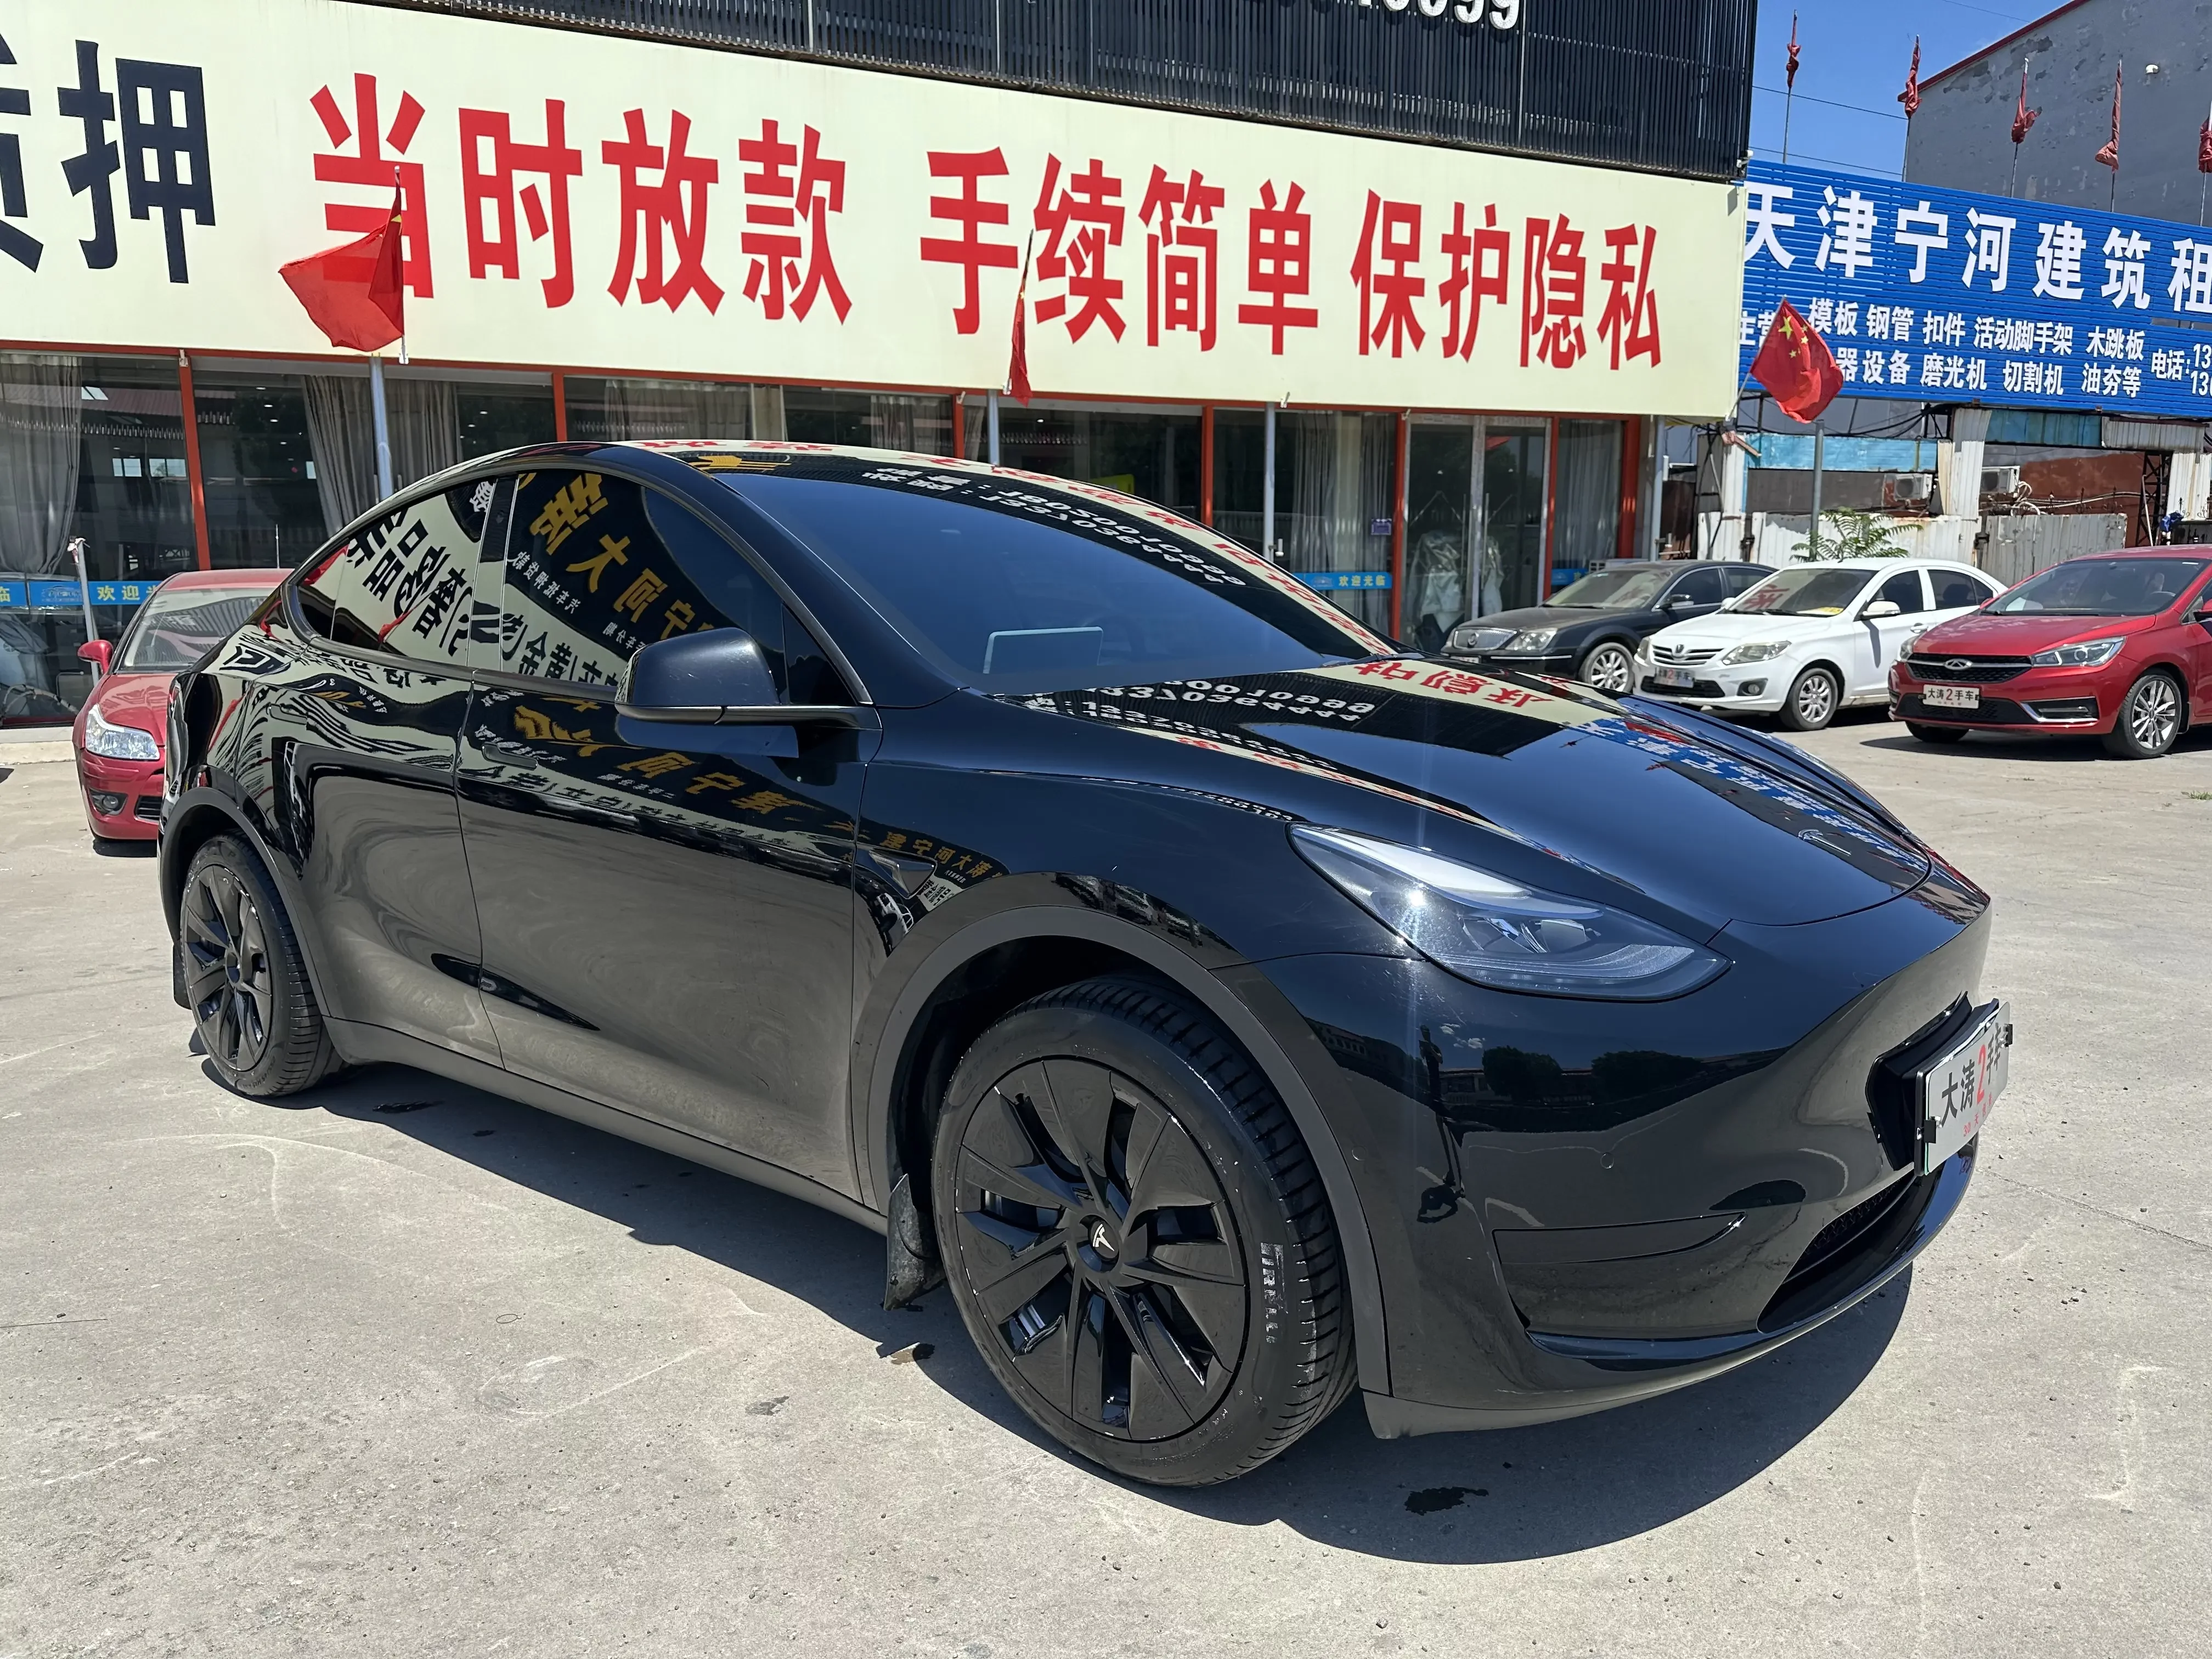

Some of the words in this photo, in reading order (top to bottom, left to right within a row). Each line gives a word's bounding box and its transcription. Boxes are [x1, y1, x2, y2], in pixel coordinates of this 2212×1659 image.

[310, 72, 853, 325] 当时放款
[920, 146, 1318, 356] 手续简单
[1350, 188, 1662, 371] 保护隐私
[1808, 297, 1859, 337] 模板
[1866, 303, 1914, 342] 钢管
[1922, 310, 1966, 347] 扣件
[1974, 316, 2073, 356] 活动脚手架
[2086, 326, 2146, 361] 木跳板
[1921, 353, 1987, 390] 磨光机
[2002, 359, 2064, 396] 切割机
[2081, 362, 2142, 398] 油夯等
[2190, 370, 2212, 397] 13
[1339, 575, 1386, 587] 欢迎光临
